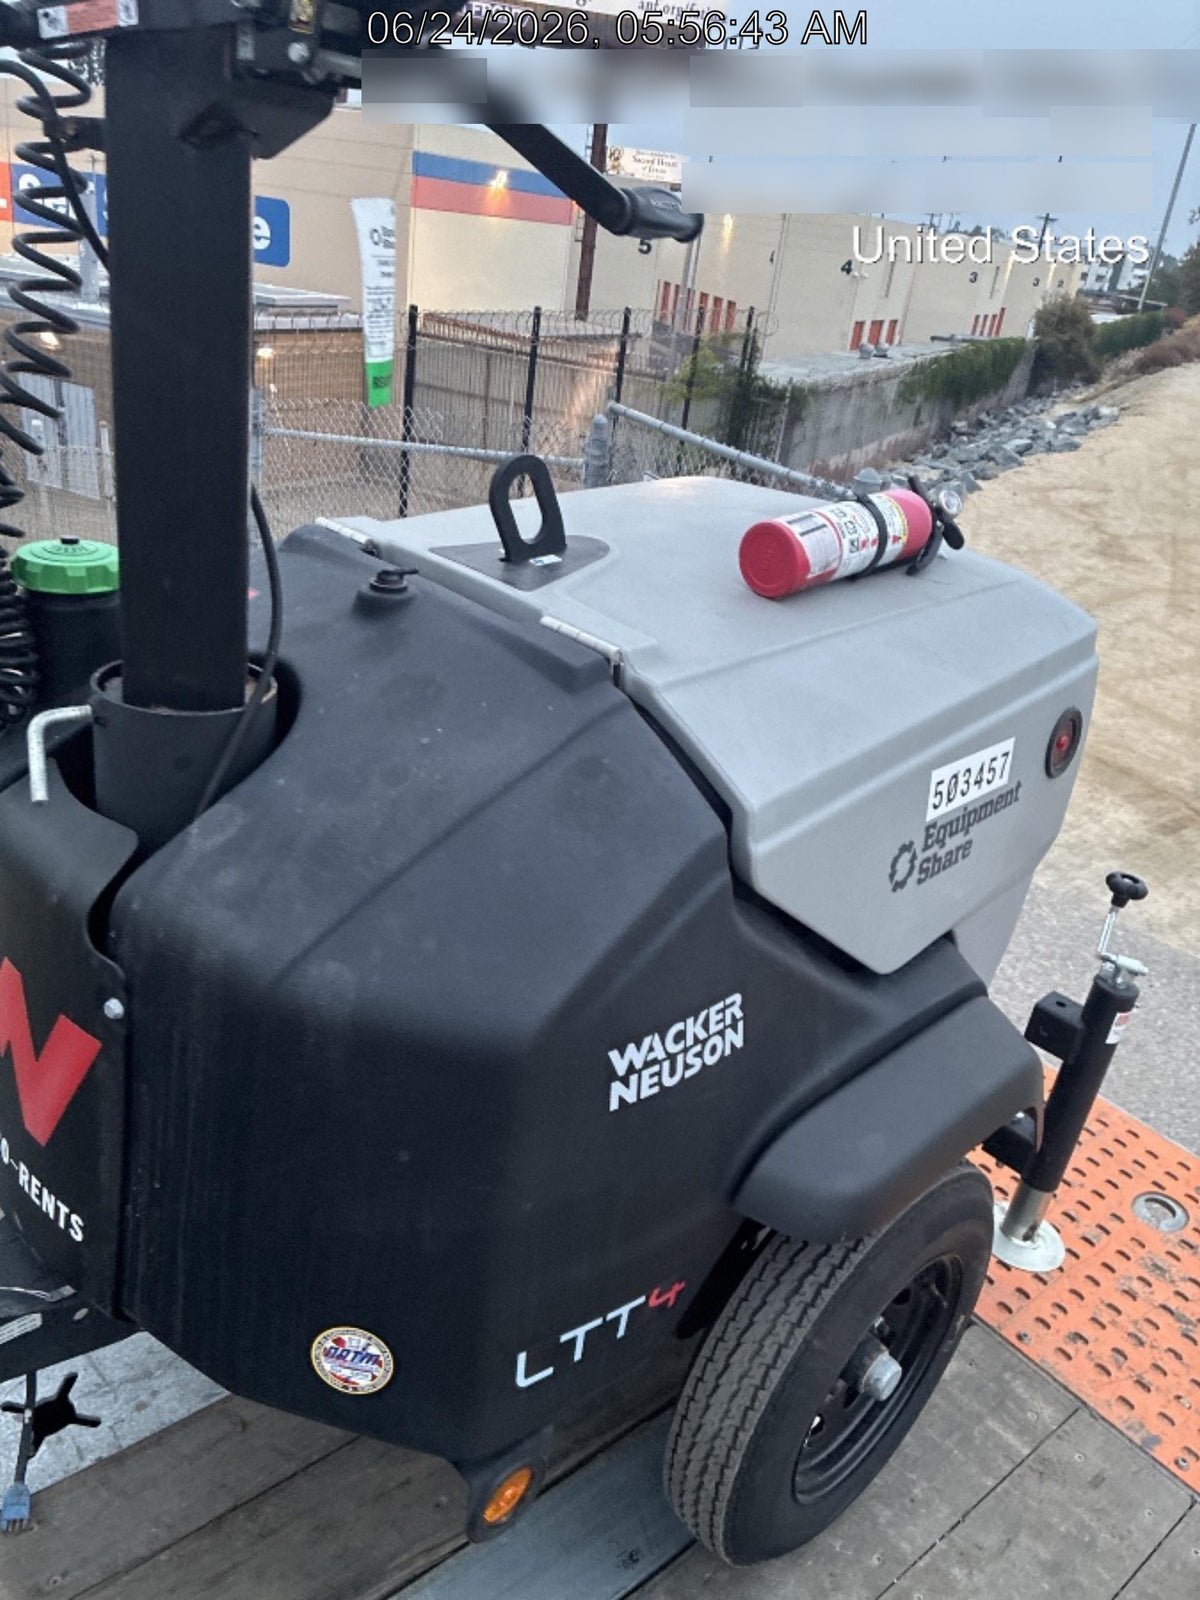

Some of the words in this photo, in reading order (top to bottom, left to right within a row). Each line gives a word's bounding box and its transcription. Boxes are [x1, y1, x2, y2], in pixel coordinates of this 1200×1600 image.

[840, 259, 853, 275] 4
[968, 271, 979, 284] 3
[1032, 277, 1041, 287] 3
[1057, 279, 1065, 288] 2
[931, 751, 1010, 810] 503457
[921, 780, 1022, 852] Equipment
[916, 839, 973, 886] Share
[607, 992, 744, 1077] WACKER
[609, 1019, 744, 1112] NEUSON
